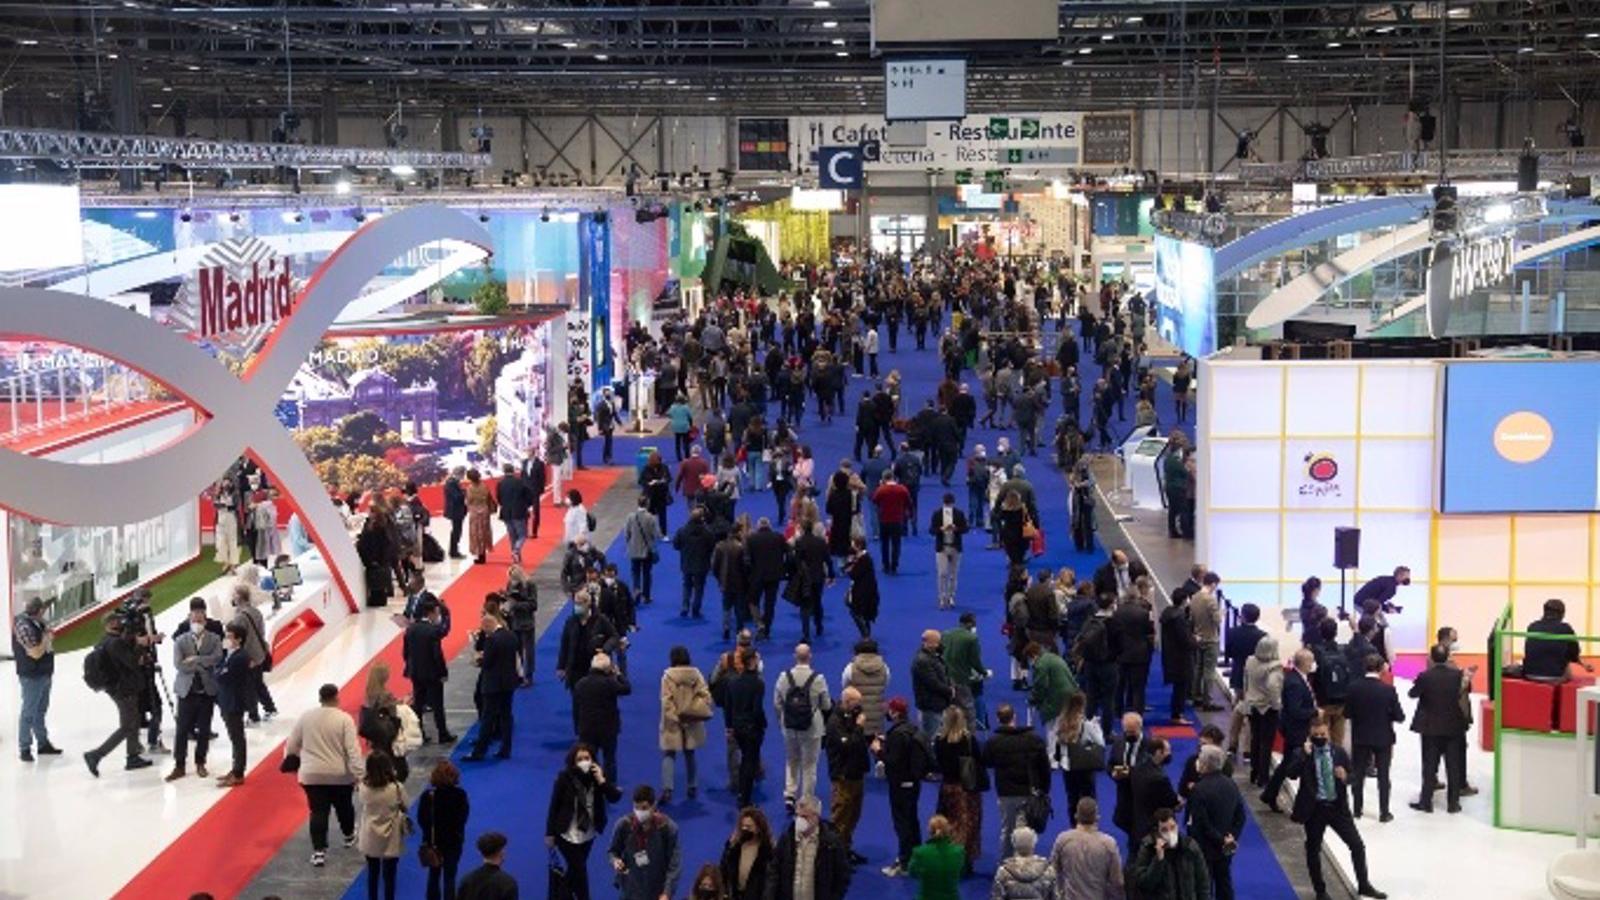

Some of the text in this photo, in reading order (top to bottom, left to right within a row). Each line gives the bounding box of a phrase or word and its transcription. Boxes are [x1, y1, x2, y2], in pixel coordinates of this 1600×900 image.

[832, 122, 888, 143] Cafet
[949, 122, 1076, 141] Restunte
[863, 143, 876, 159] C
[828, 151, 854, 183] C
[199, 256, 291, 337] Madrid
[309, 351, 379, 364] MADRID
